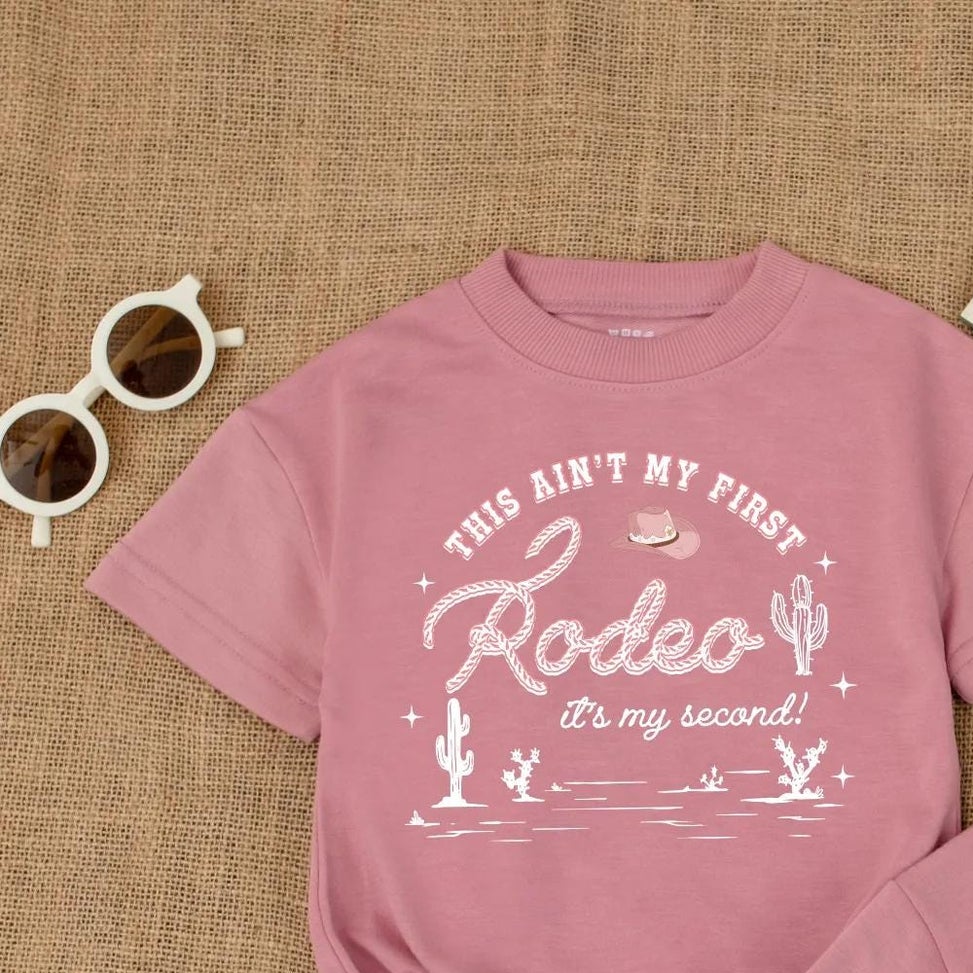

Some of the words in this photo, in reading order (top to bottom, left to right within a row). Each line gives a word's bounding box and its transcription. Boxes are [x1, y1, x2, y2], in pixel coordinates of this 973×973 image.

[444, 487, 521, 561] THIS
[530, 452, 627, 504] AIN'T
[644, 453, 700, 492] MY
[707, 472, 807, 555] FIRST
[422, 515, 765, 696] Rodeo
[560, 696, 611, 729] it's
[618, 707, 671, 741] my
[680, 691, 809, 728] second!
